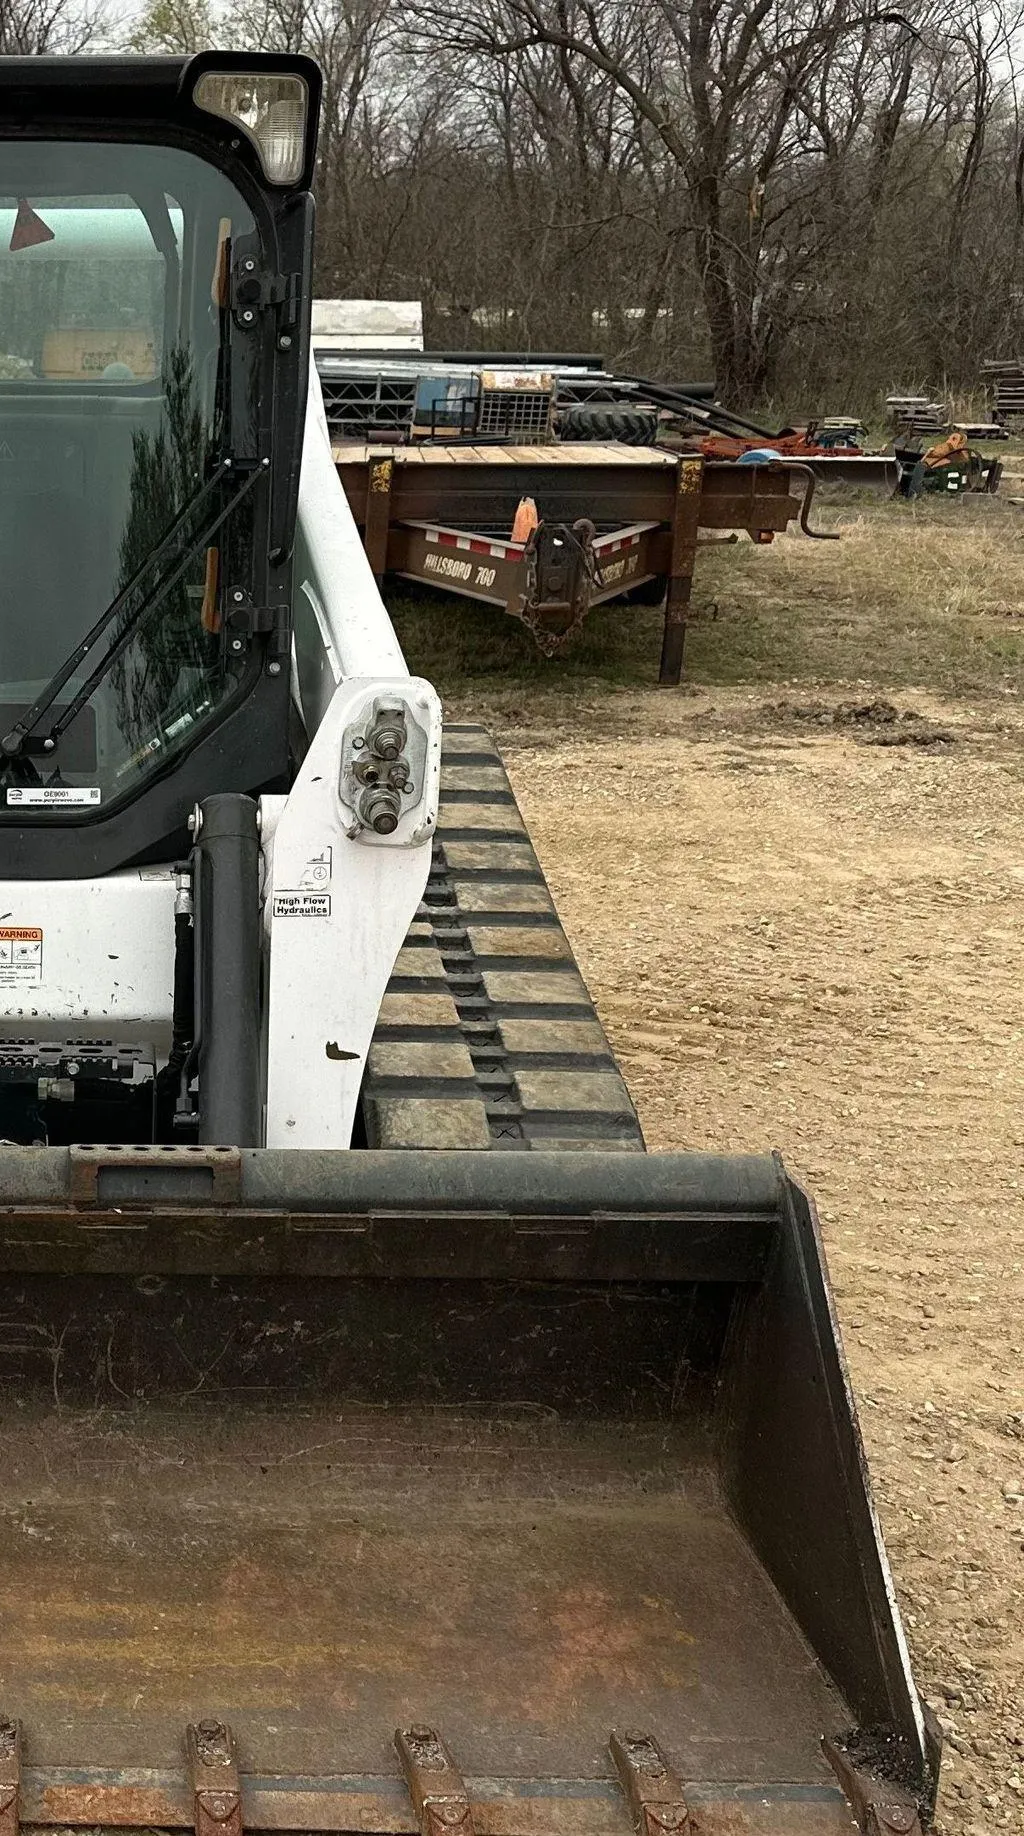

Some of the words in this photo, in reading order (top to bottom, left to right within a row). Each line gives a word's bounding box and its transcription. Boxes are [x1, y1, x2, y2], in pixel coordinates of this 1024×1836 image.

[424, 553, 472, 580] HILLSBORO
[475, 566, 496, 587] 700
[278, 897, 300, 906] High
[303, 897, 326, 905] Flow
[276, 906, 328, 915] Hydraulics
